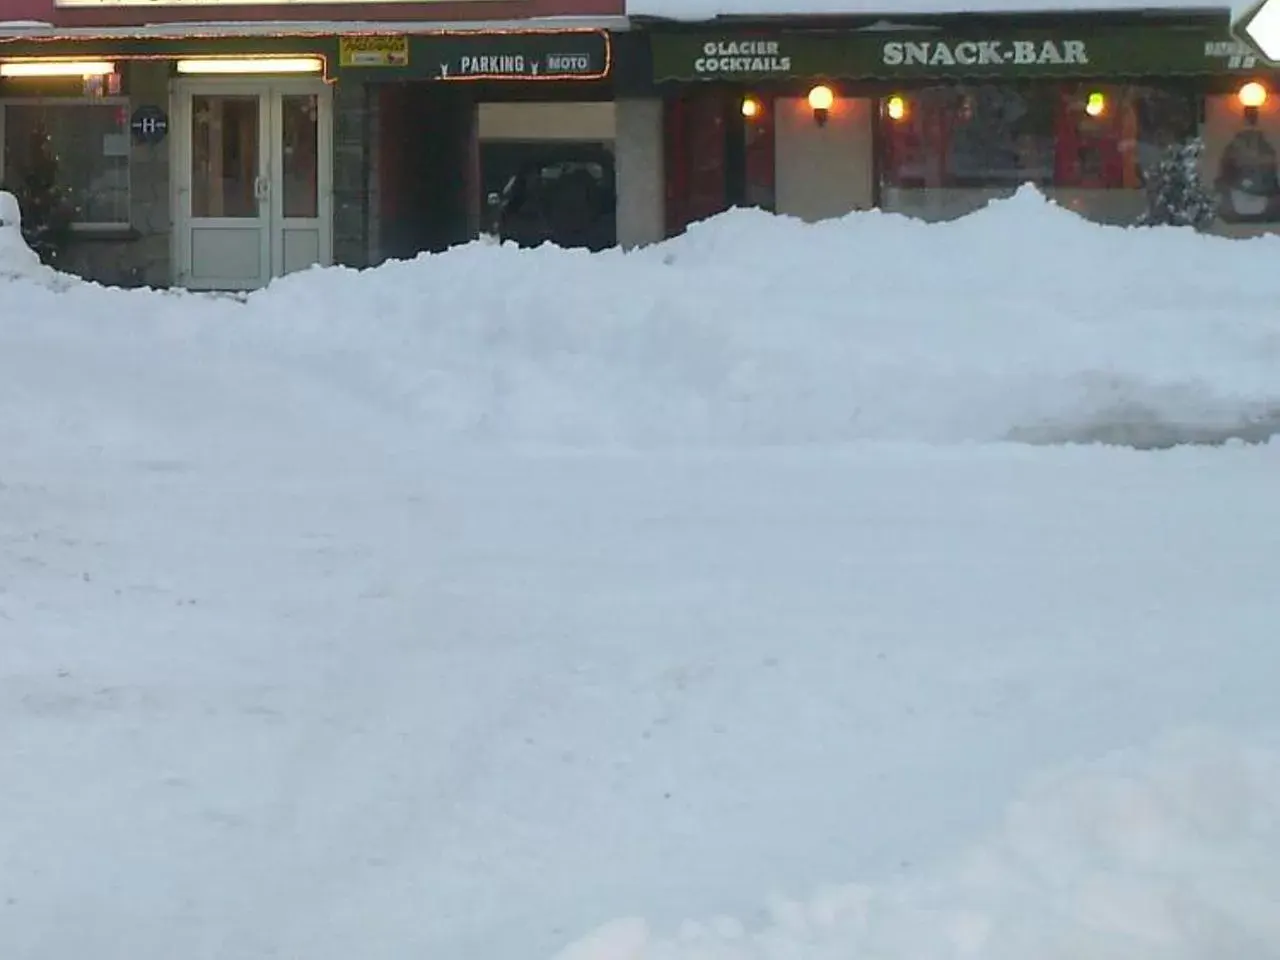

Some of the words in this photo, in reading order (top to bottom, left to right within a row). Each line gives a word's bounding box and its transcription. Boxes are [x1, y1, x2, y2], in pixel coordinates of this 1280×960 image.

[703, 41, 779, 56] GLACIER
[883, 40, 1088, 65] SNACK-BAR
[460, 55, 524, 73] PARKING
[694, 57, 791, 72] COCKTAILS
